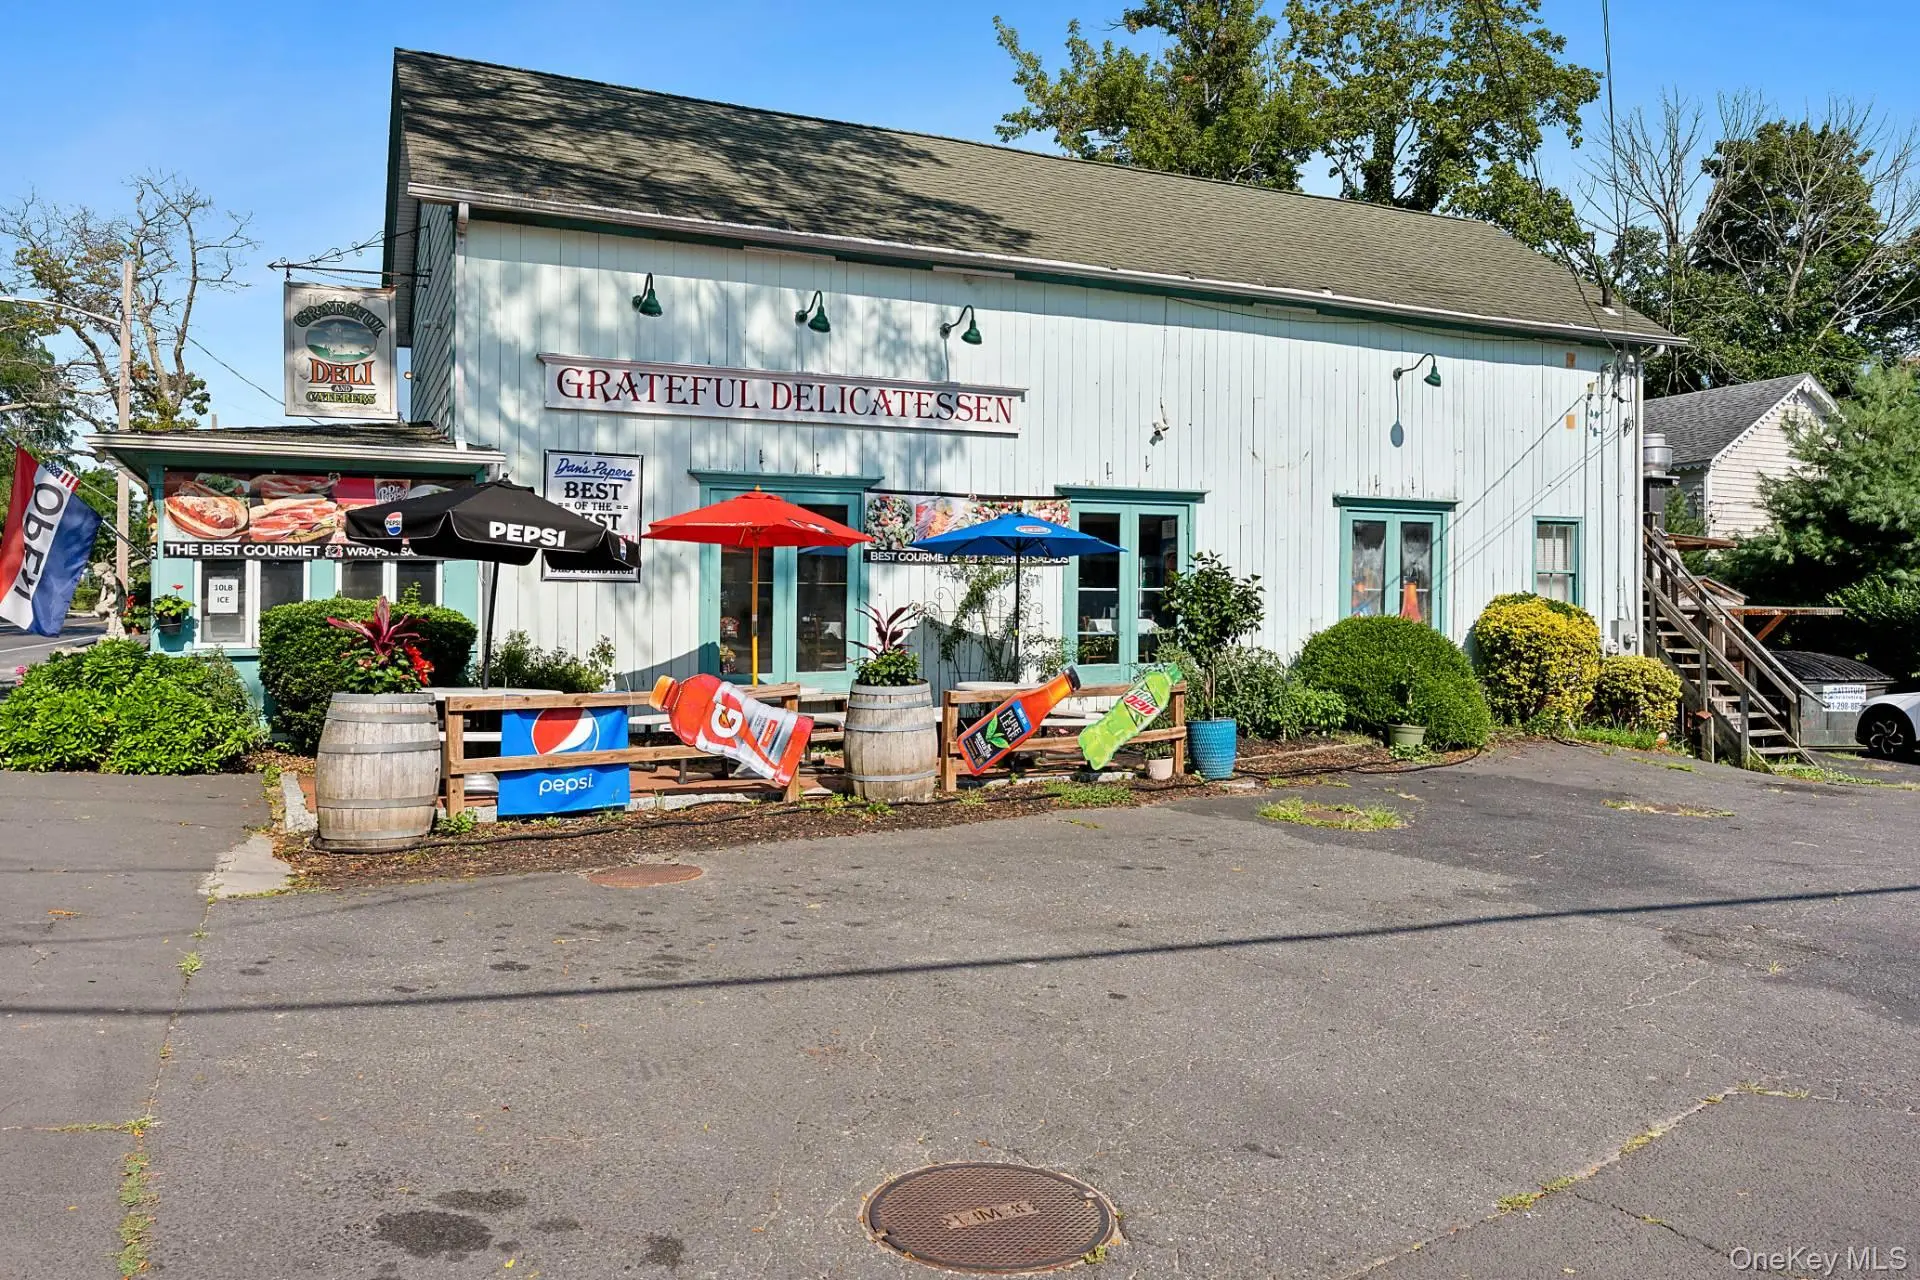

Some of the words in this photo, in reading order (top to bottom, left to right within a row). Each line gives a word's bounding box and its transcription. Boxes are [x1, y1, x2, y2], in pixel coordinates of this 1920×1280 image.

[293, 300, 387, 338] GRATEFUL
[308, 358, 375, 385] DELI
[306, 392, 376, 405] CATERERS
[557, 368, 760, 409] GRATEFUL
[771, 382, 1013, 424] DELICATESSEN
[555, 458, 589, 475] Dan's
[592, 461, 634, 481] Papers
[565, 481, 622, 500] BEST
[574, 502, 588, 510] OF
[592, 502, 612, 511] THE
[14, 483, 64, 601] OPEN
[489, 521, 566, 547] PEPSI
[167, 543, 198, 555] THE
[202, 544, 242, 556] BEST
[243, 545, 320, 557] GOURMET
[346, 547, 389, 557] WRAPS
[870, 551, 897, 560] BEST
[898, 553, 948, 562] GOURMET
[711, 703, 743, 738] G
[999, 714, 1014, 741] LEAF
[1005, 709, 1022, 735] PURE
[539, 773, 593, 796] pepsi
